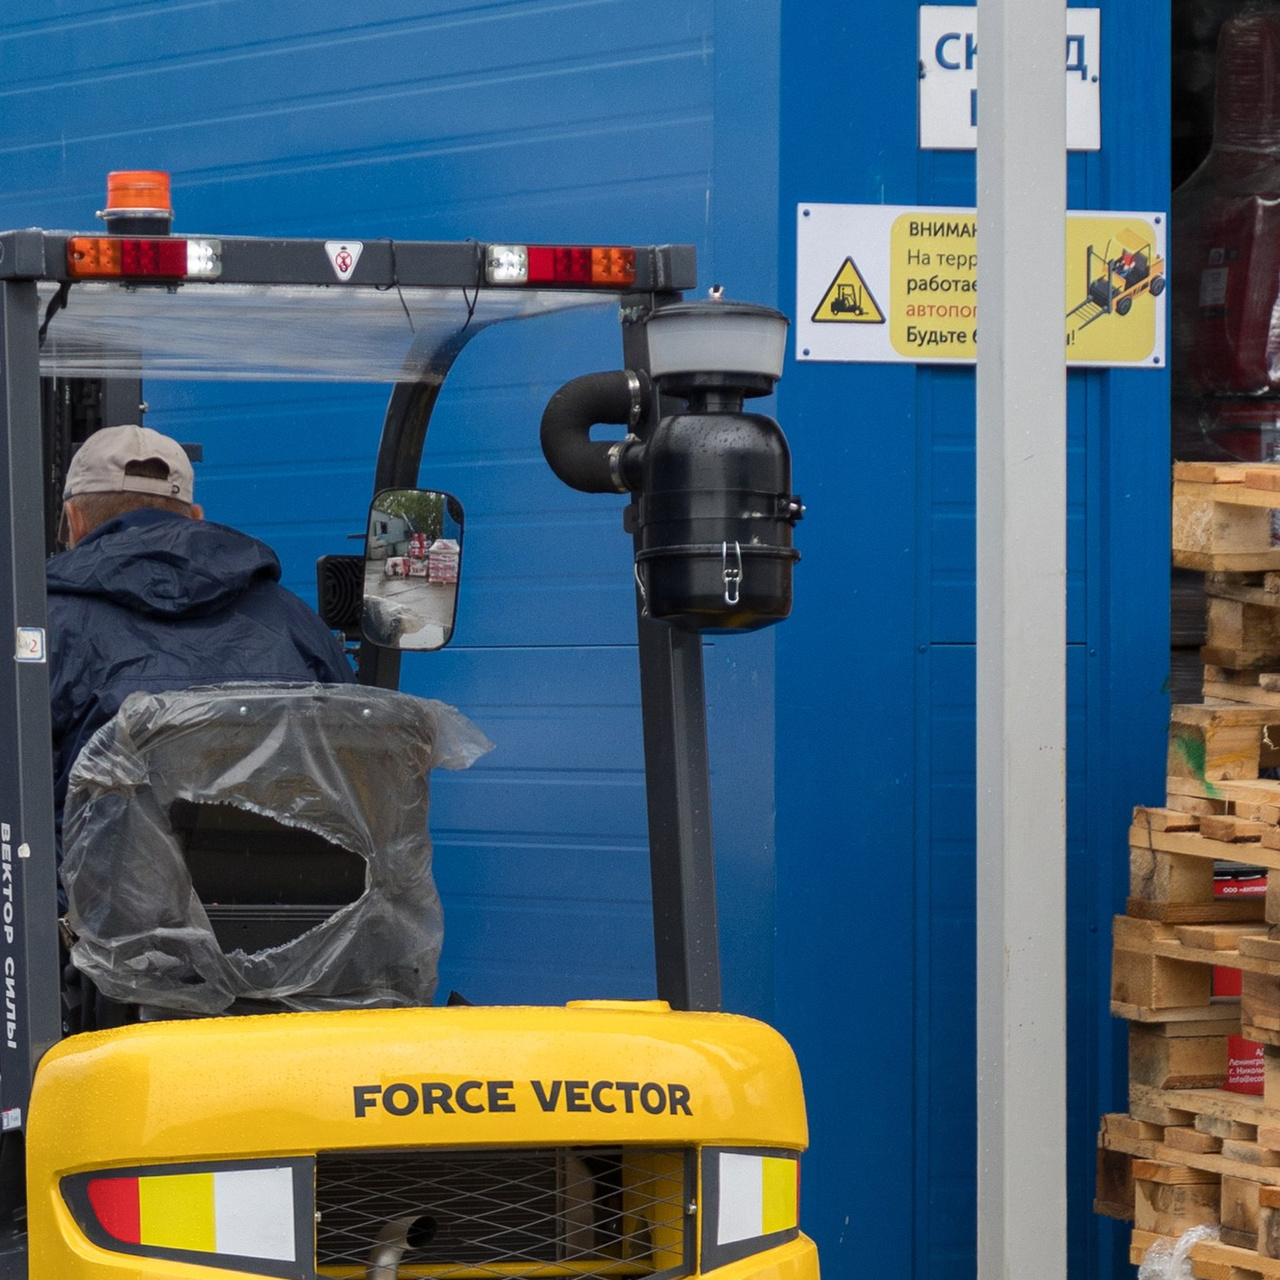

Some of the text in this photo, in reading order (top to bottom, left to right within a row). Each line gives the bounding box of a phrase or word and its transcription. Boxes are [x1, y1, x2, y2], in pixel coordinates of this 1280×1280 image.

[907, 249, 977, 270] На терр
[906, 326, 968, 348] Будьте
[1, 822, 17, 1050] ВЕКТОР СИЛЫ
[353, 1080, 694, 1118] FORCE VECTOR
